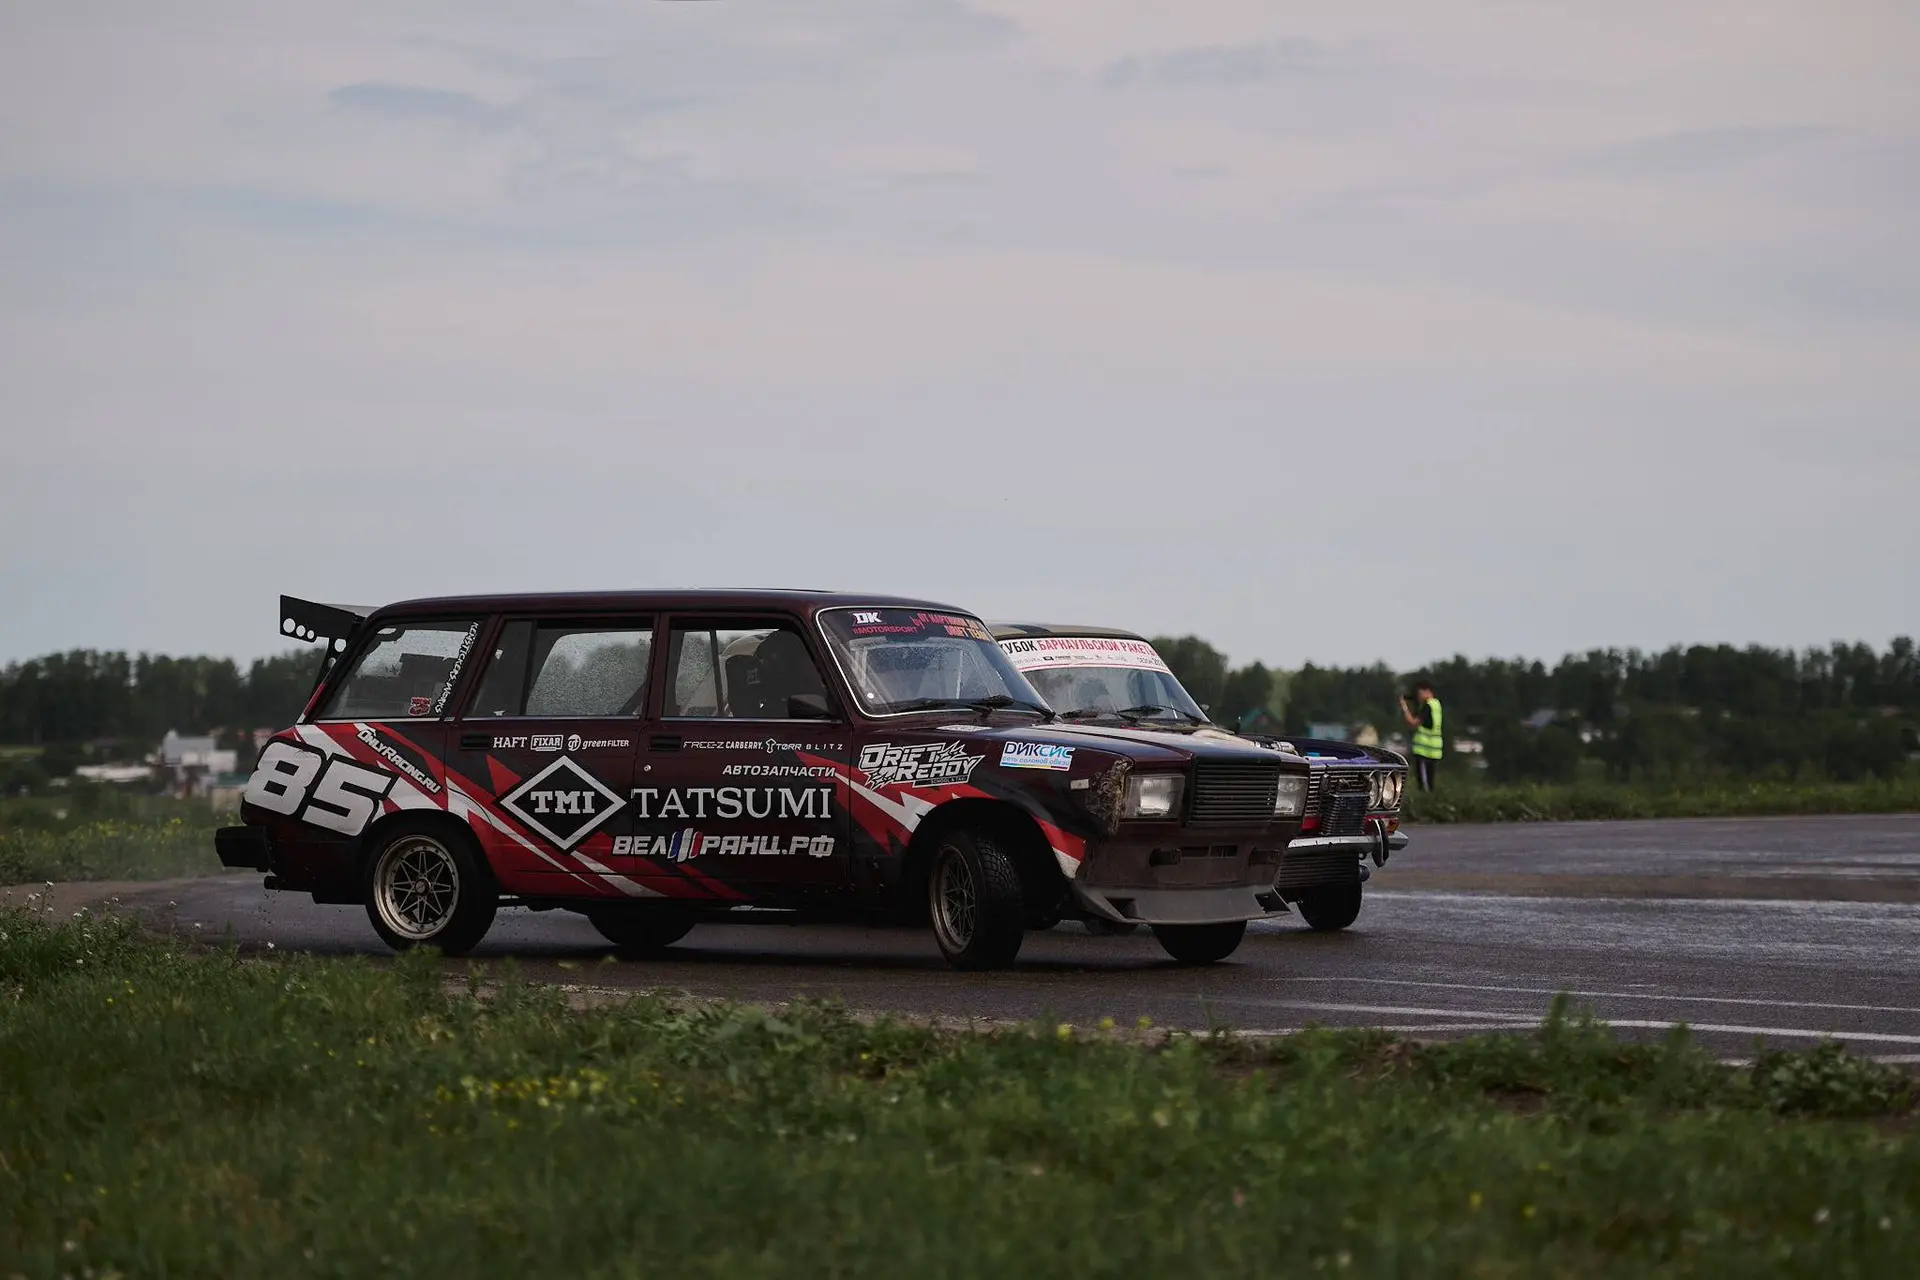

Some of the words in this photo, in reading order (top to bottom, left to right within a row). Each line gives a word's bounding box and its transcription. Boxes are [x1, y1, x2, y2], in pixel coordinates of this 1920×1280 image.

[853, 612, 882, 624] DK
[1037, 639, 1120, 651] БАРНАУЛЬСКОЙ
[493, 736, 527, 748] HAFT
[533, 737, 561, 746] FIXAR
[722, 765, 836, 777] АВТОЗАПЧАСТИ
[895, 758, 977, 781] READY
[242, 741, 392, 836] 85
[530, 791, 595, 814] TMI
[631, 787, 832, 818] TATSUMI
